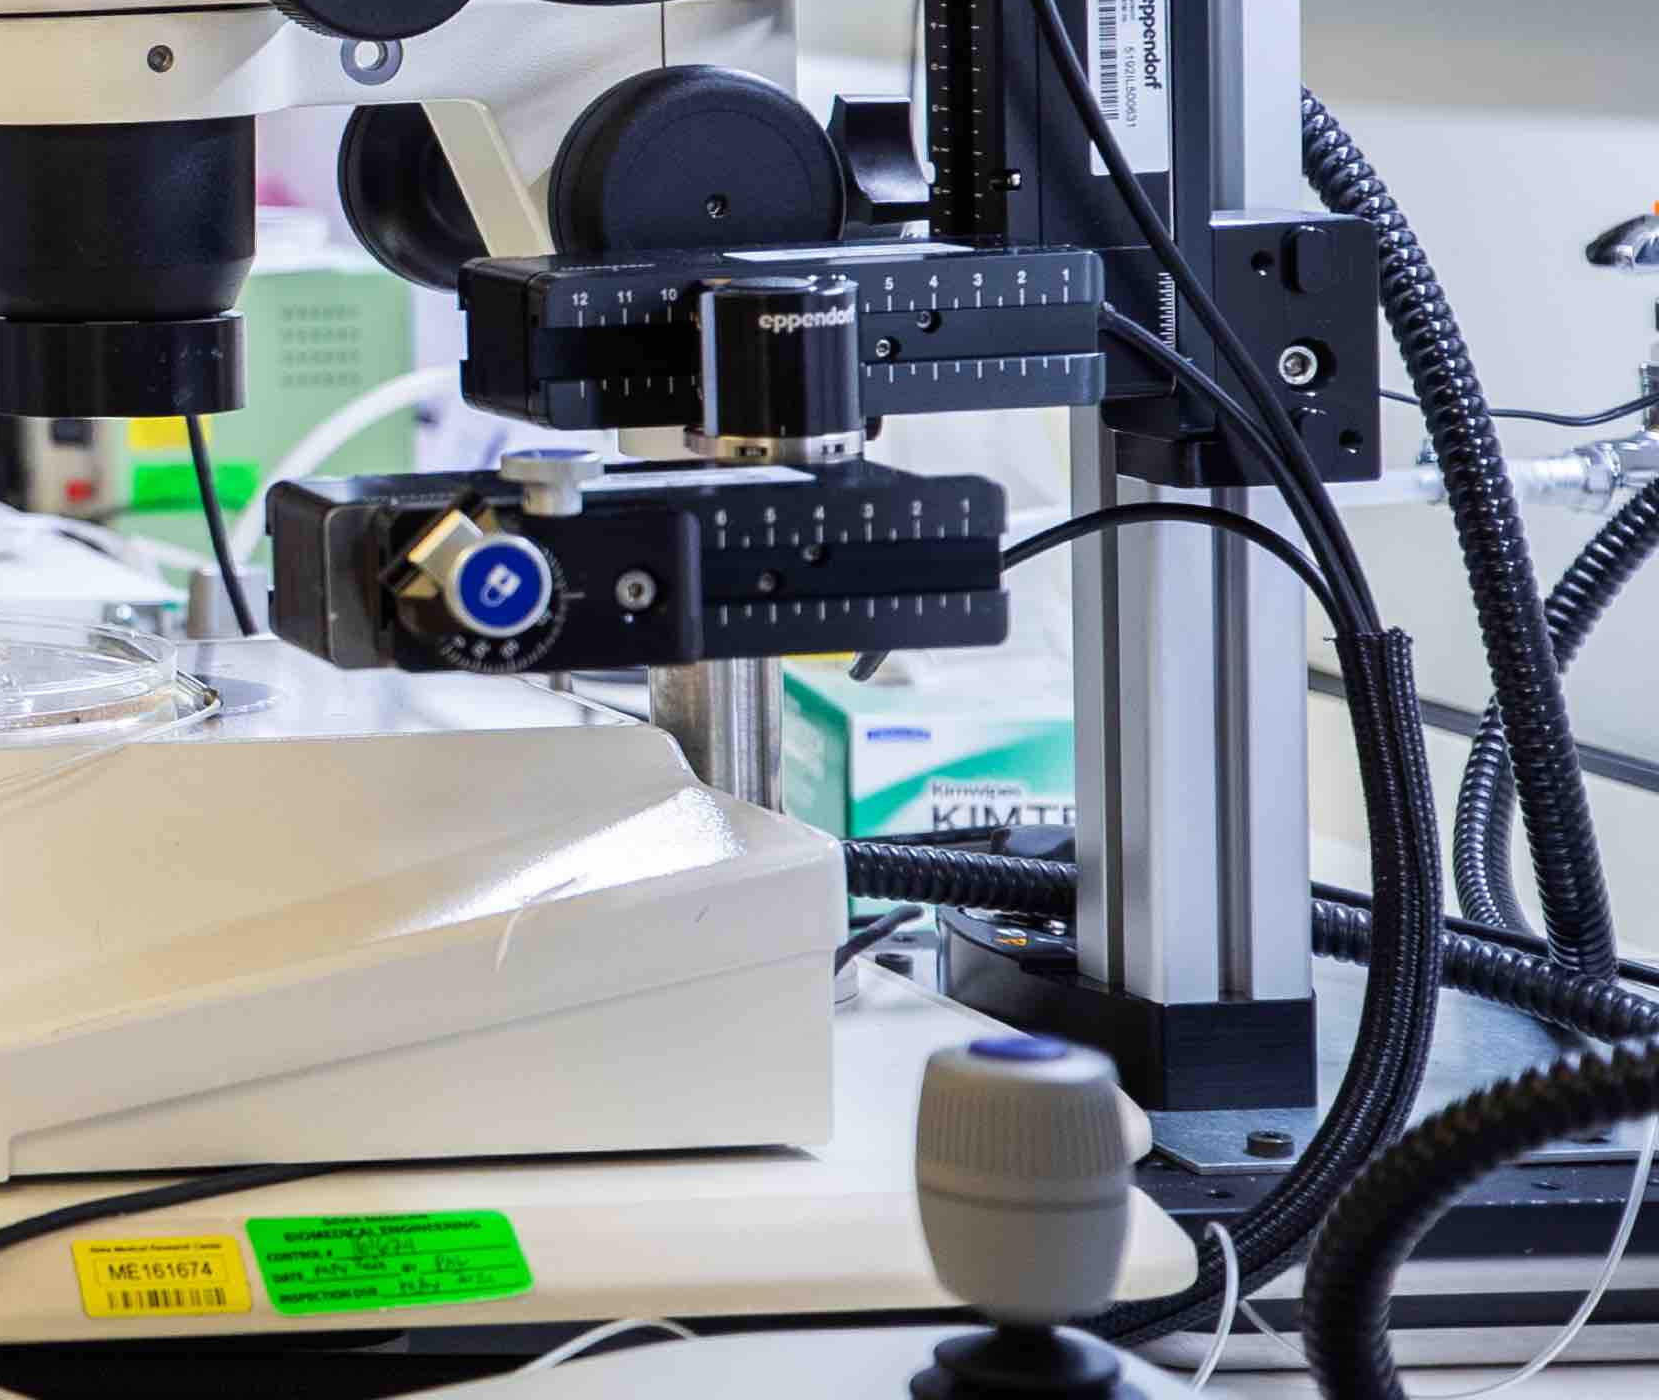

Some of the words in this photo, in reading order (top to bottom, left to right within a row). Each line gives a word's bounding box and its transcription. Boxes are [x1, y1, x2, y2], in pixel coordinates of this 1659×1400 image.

[571, 291, 589, 307] 12
[617, 290, 633, 304] 11
[660, 288, 678, 302] 10
[884, 276, 895, 290] 5
[928, 275, 939, 288] 4
[972, 272, 984, 287] 3
[1016, 270, 1028, 285] 2
[1061, 268, 1071, 282] 1
[758, 302, 857, 333] eppendorf
[911, 499, 923, 516] 2
[960, 497, 971, 514] 1
[107, 1261, 213, 1280] ME161674
